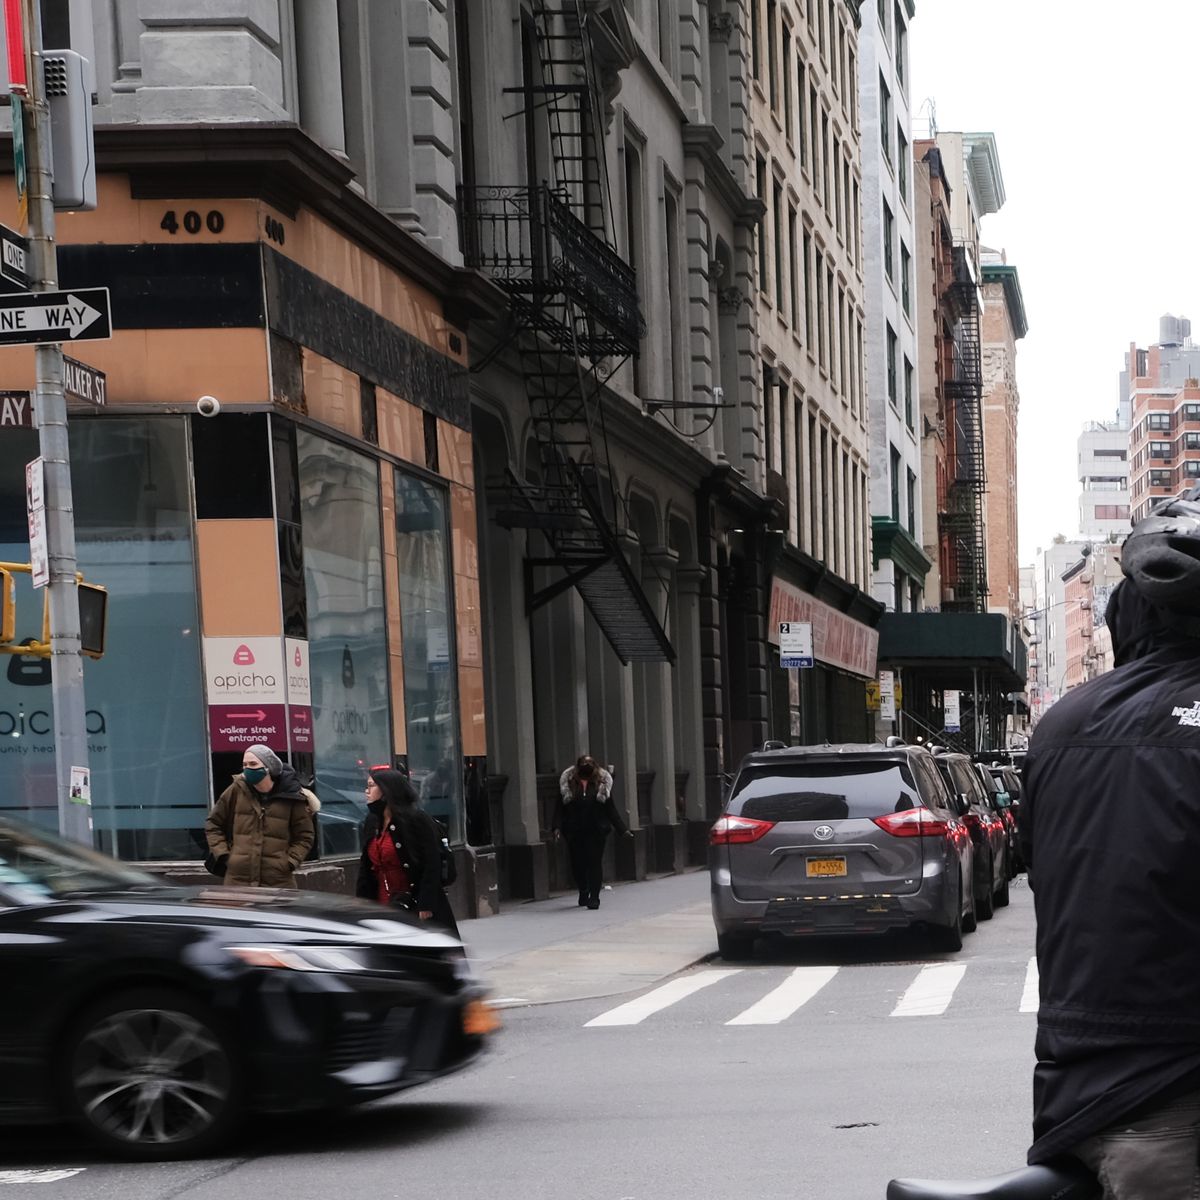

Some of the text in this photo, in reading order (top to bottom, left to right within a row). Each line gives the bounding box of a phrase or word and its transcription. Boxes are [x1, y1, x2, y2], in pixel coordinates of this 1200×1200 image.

[160, 210, 224, 235] 400
[7, 244, 24, 270] ONE
[45, 306, 87, 327] WAY
[63, 361, 105, 406] ALKER ST
[214, 672, 276, 690] apicha
[219, 726, 276, 734] walker street
[228, 734, 268, 742] entrance
